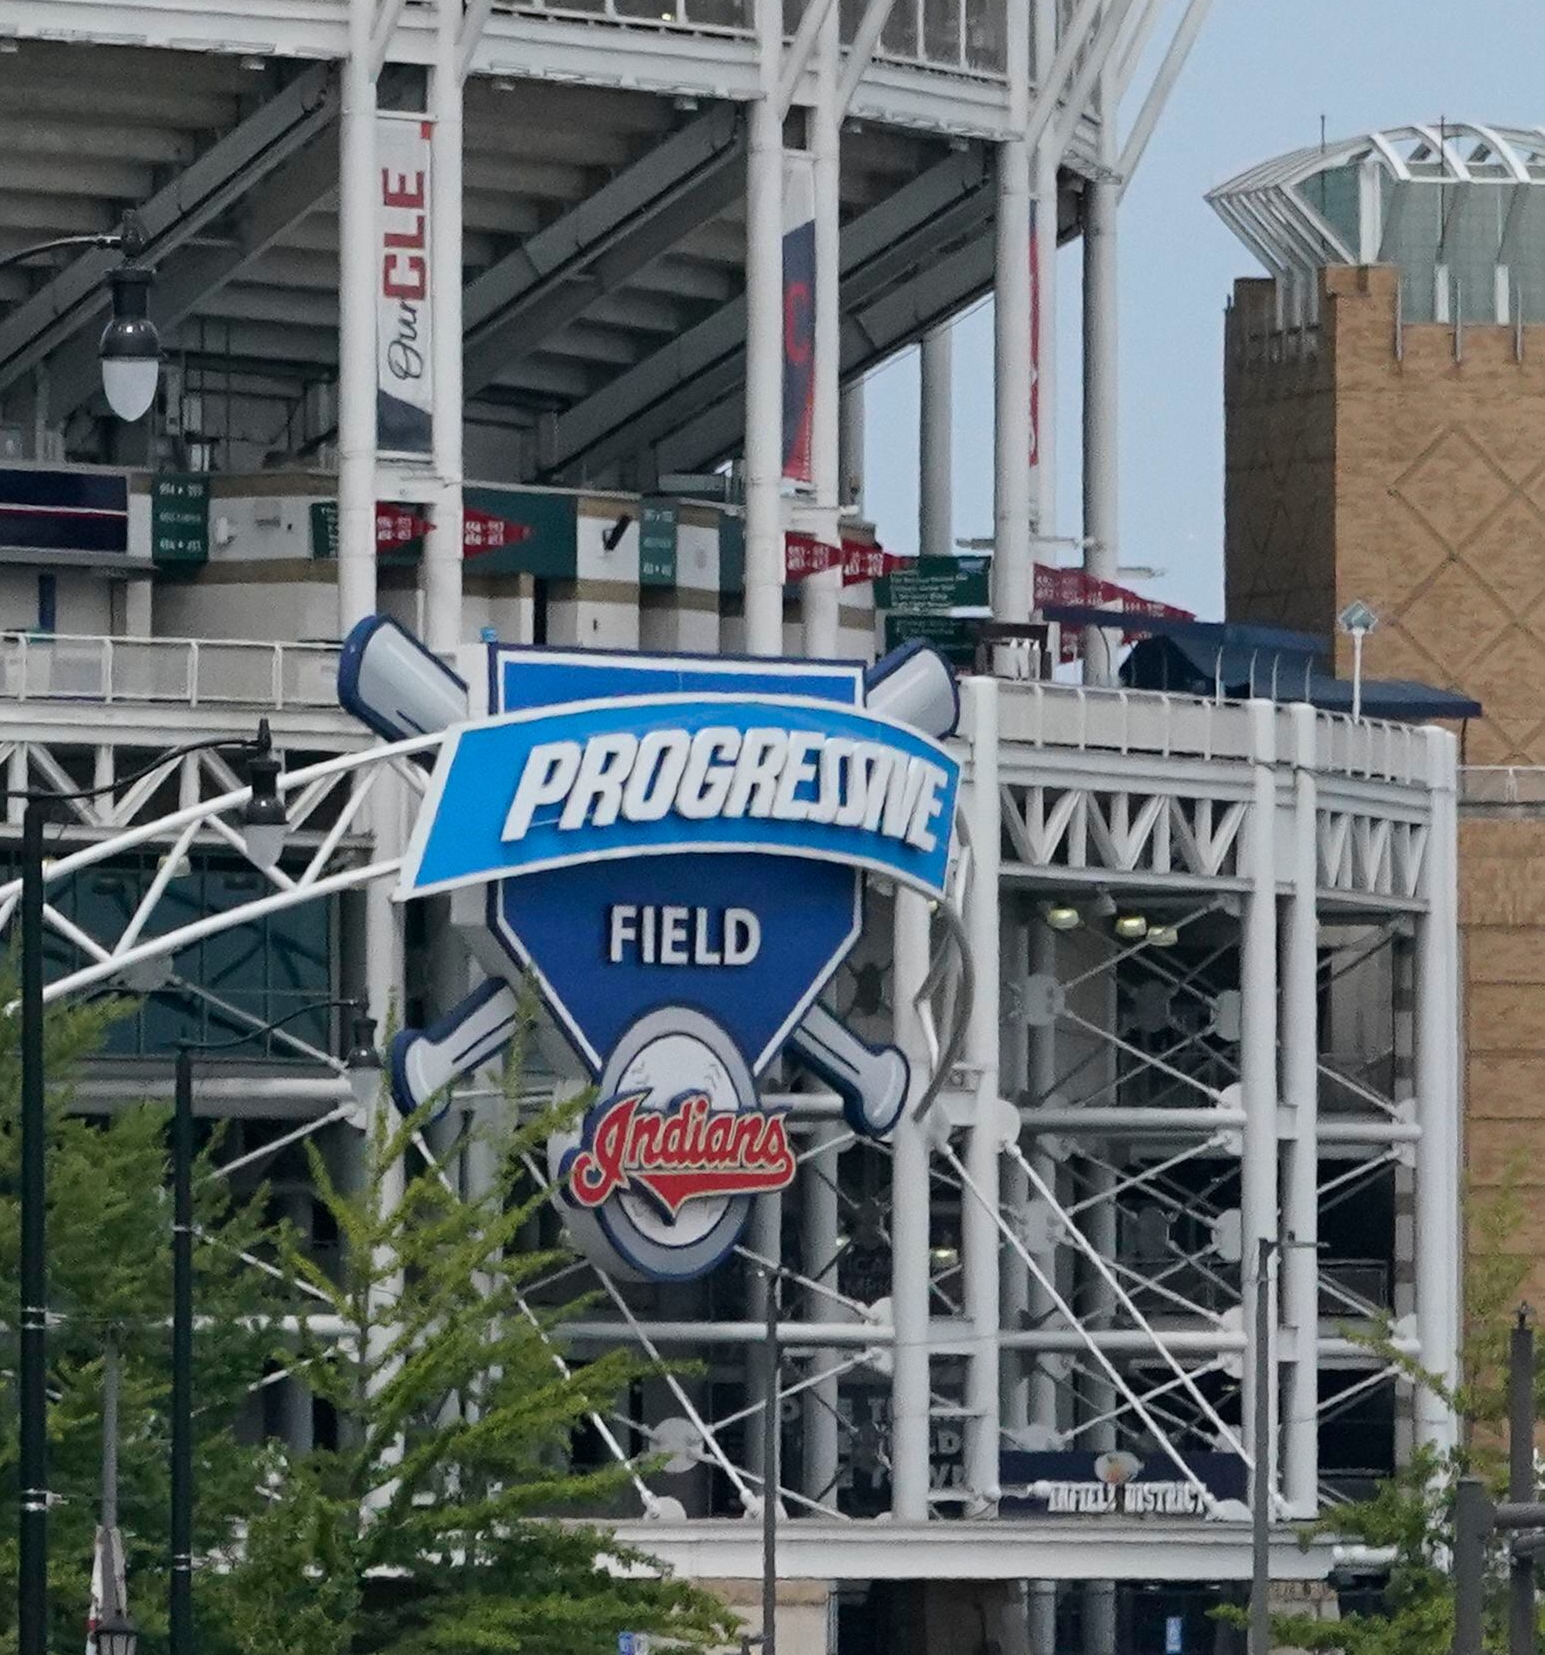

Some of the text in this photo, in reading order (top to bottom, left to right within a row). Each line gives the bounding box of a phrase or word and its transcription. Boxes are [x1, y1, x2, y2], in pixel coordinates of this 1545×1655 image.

[382, 168, 426, 300] CLE
[387, 296, 424, 379] Our
[500, 727, 949, 852] PROGRESSIVE
[610, 904, 761, 966] FIELD
[569, 1093, 796, 1218] Indians
